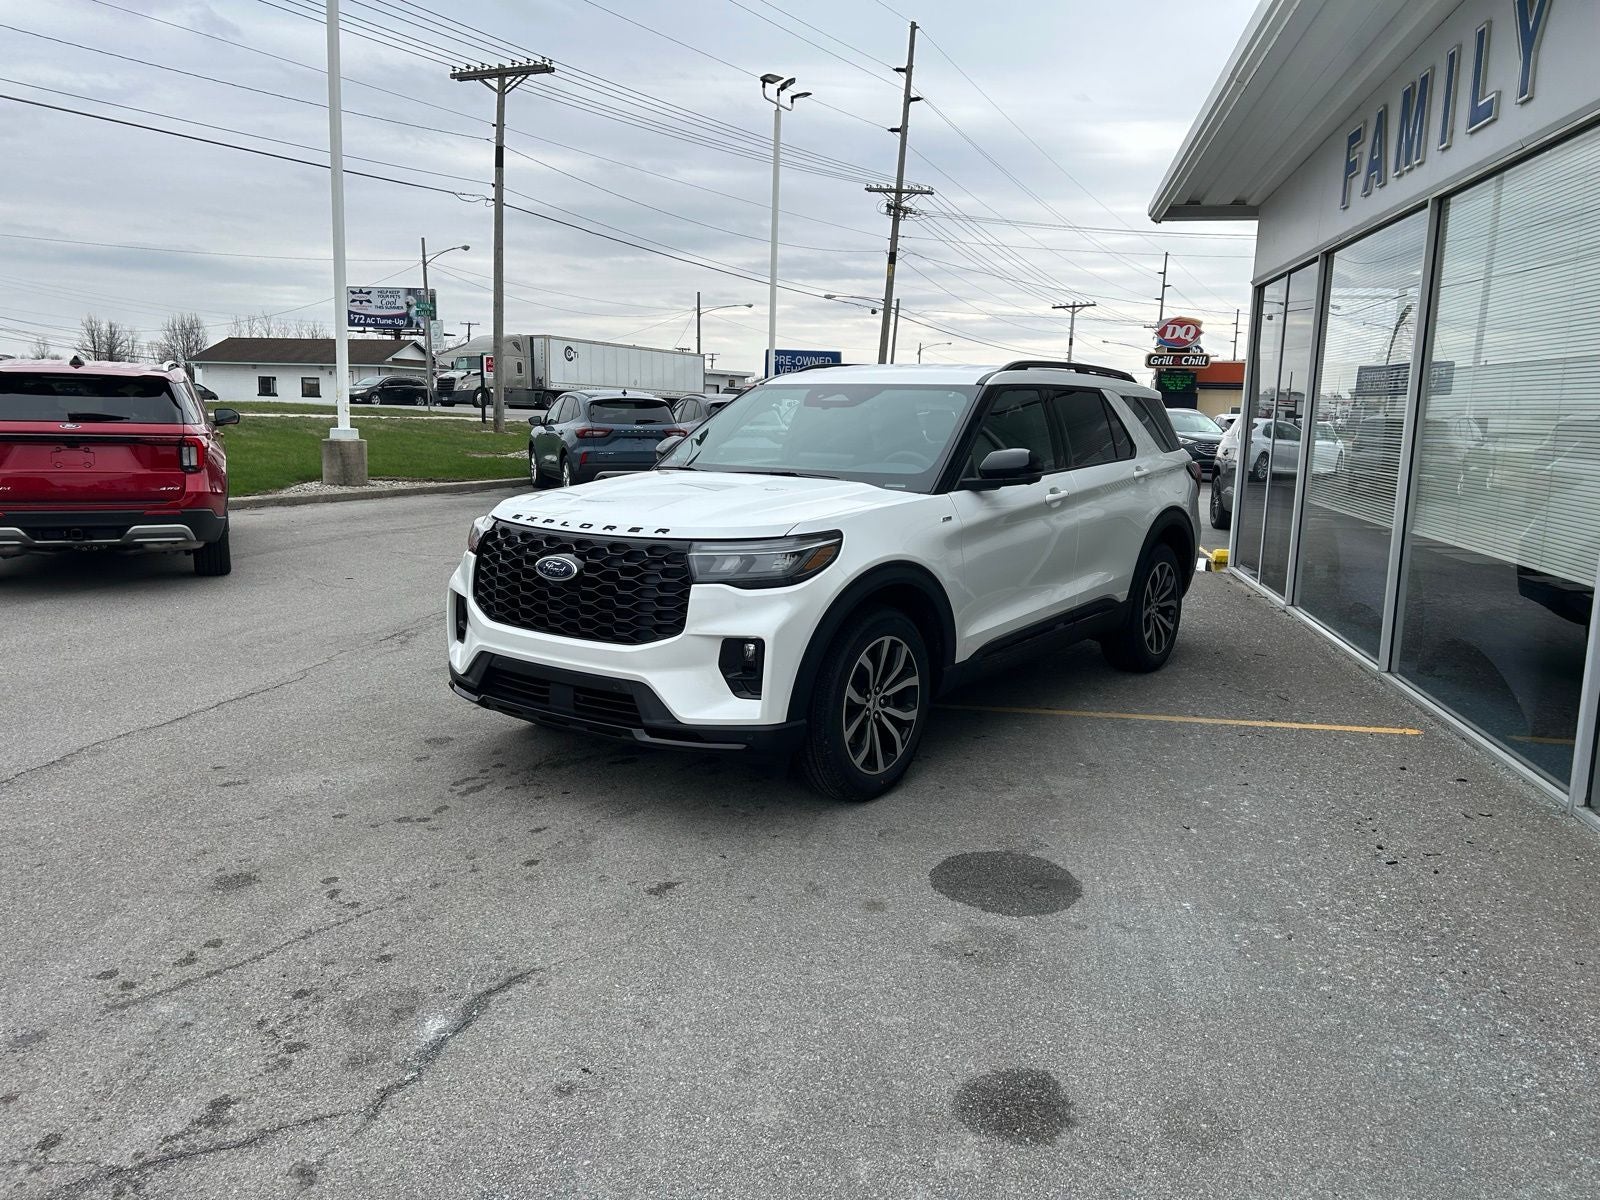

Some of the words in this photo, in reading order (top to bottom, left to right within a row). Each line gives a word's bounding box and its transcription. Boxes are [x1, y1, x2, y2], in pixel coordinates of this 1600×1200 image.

[1340, 0, 1552, 210] FAMILY
[350, 314, 365, 324] $72
[376, 318, 404, 326] Tune-Up
[1164, 324, 1196, 341] DQ
[1150, 355, 1174, 365] Grill
[1181, 356, 1206, 365] Chill
[512, 514, 671, 534] EXPLORER
[544, 560, 566, 574] Ford
